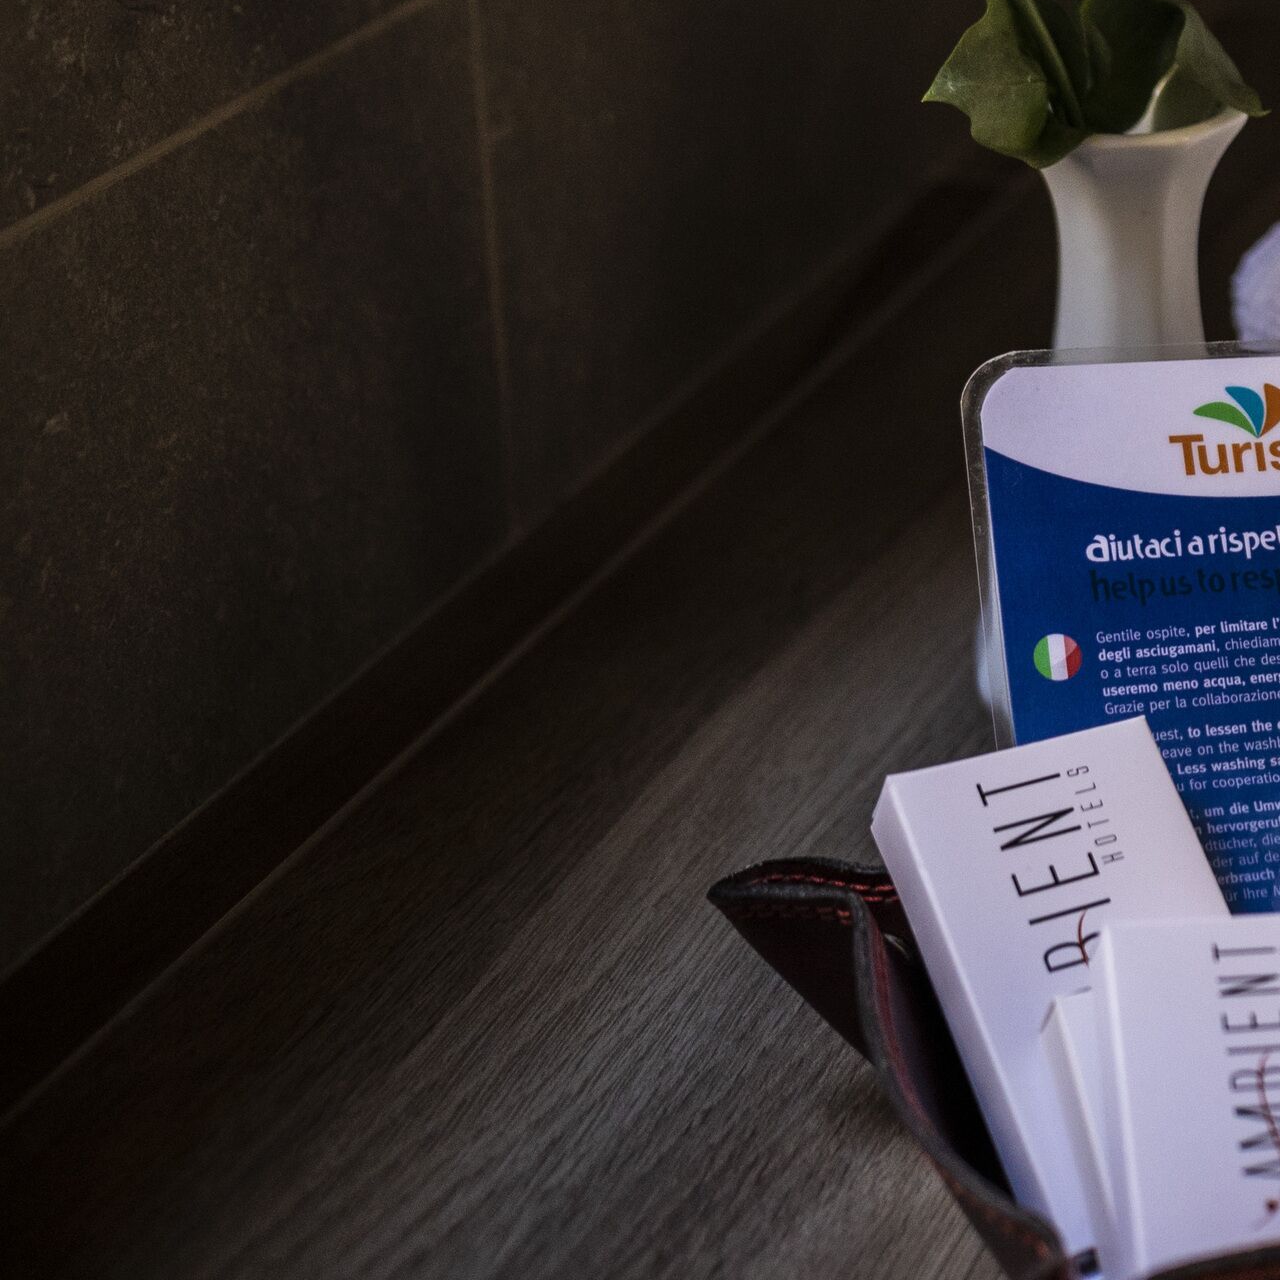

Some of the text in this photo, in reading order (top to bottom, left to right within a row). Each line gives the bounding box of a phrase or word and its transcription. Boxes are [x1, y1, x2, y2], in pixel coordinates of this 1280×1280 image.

[1085, 529, 1182, 562] aiutaci
[1187, 536, 1205, 555] a
[1089, 569, 1157, 606] help
[1160, 574, 1193, 597] us
[1197, 569, 1226, 594] to
[1095, 629, 1141, 643] Gentile
[1145, 626, 1191, 640] ospite,
[1194, 625, 1217, 638] per
[1219, 620, 1269, 633] limitare
[1097, 647, 1131, 662] degli
[1135, 640, 1221, 658] asciugamani,
[1100, 670, 1109, 679] o
[1113, 669, 1122, 678] a
[1126, 666, 1157, 676] terra
[1161, 661, 1189, 673] solo
[1193, 656, 1229, 672] quelli
[1233, 656, 1256, 667] che
[1102, 683, 1159, 696] useremo
[1162, 680, 1199, 691] meno
[1203, 676, 1246, 689] acqua,
[1104, 700, 1145, 714] Grazie
[1149, 700, 1171, 713] per
[1175, 696, 1187, 708] la
[1152, 729, 1184, 742] uest,
[1187, 727, 1201, 738] to
[1205, 724, 1248, 736] lessen
[1251, 720, 1273, 732] the
[1159, 747, 1193, 759] eave
[1197, 746, 1214, 755] on
[1218, 741, 1239, 753] the
[1176, 764, 1207, 774] Less
[1210, 757, 1266, 772] washing
[1189, 779, 1207, 791] for
[1066, 765, 1125, 865] HOTELS
[1204, 807, 1225, 817] um
[1229, 802, 1250, 815] die
[1239, 851, 1259, 865] auf
[1217, 867, 1275, 885] erbrauch
[1242, 887, 1268, 900] Ihre
